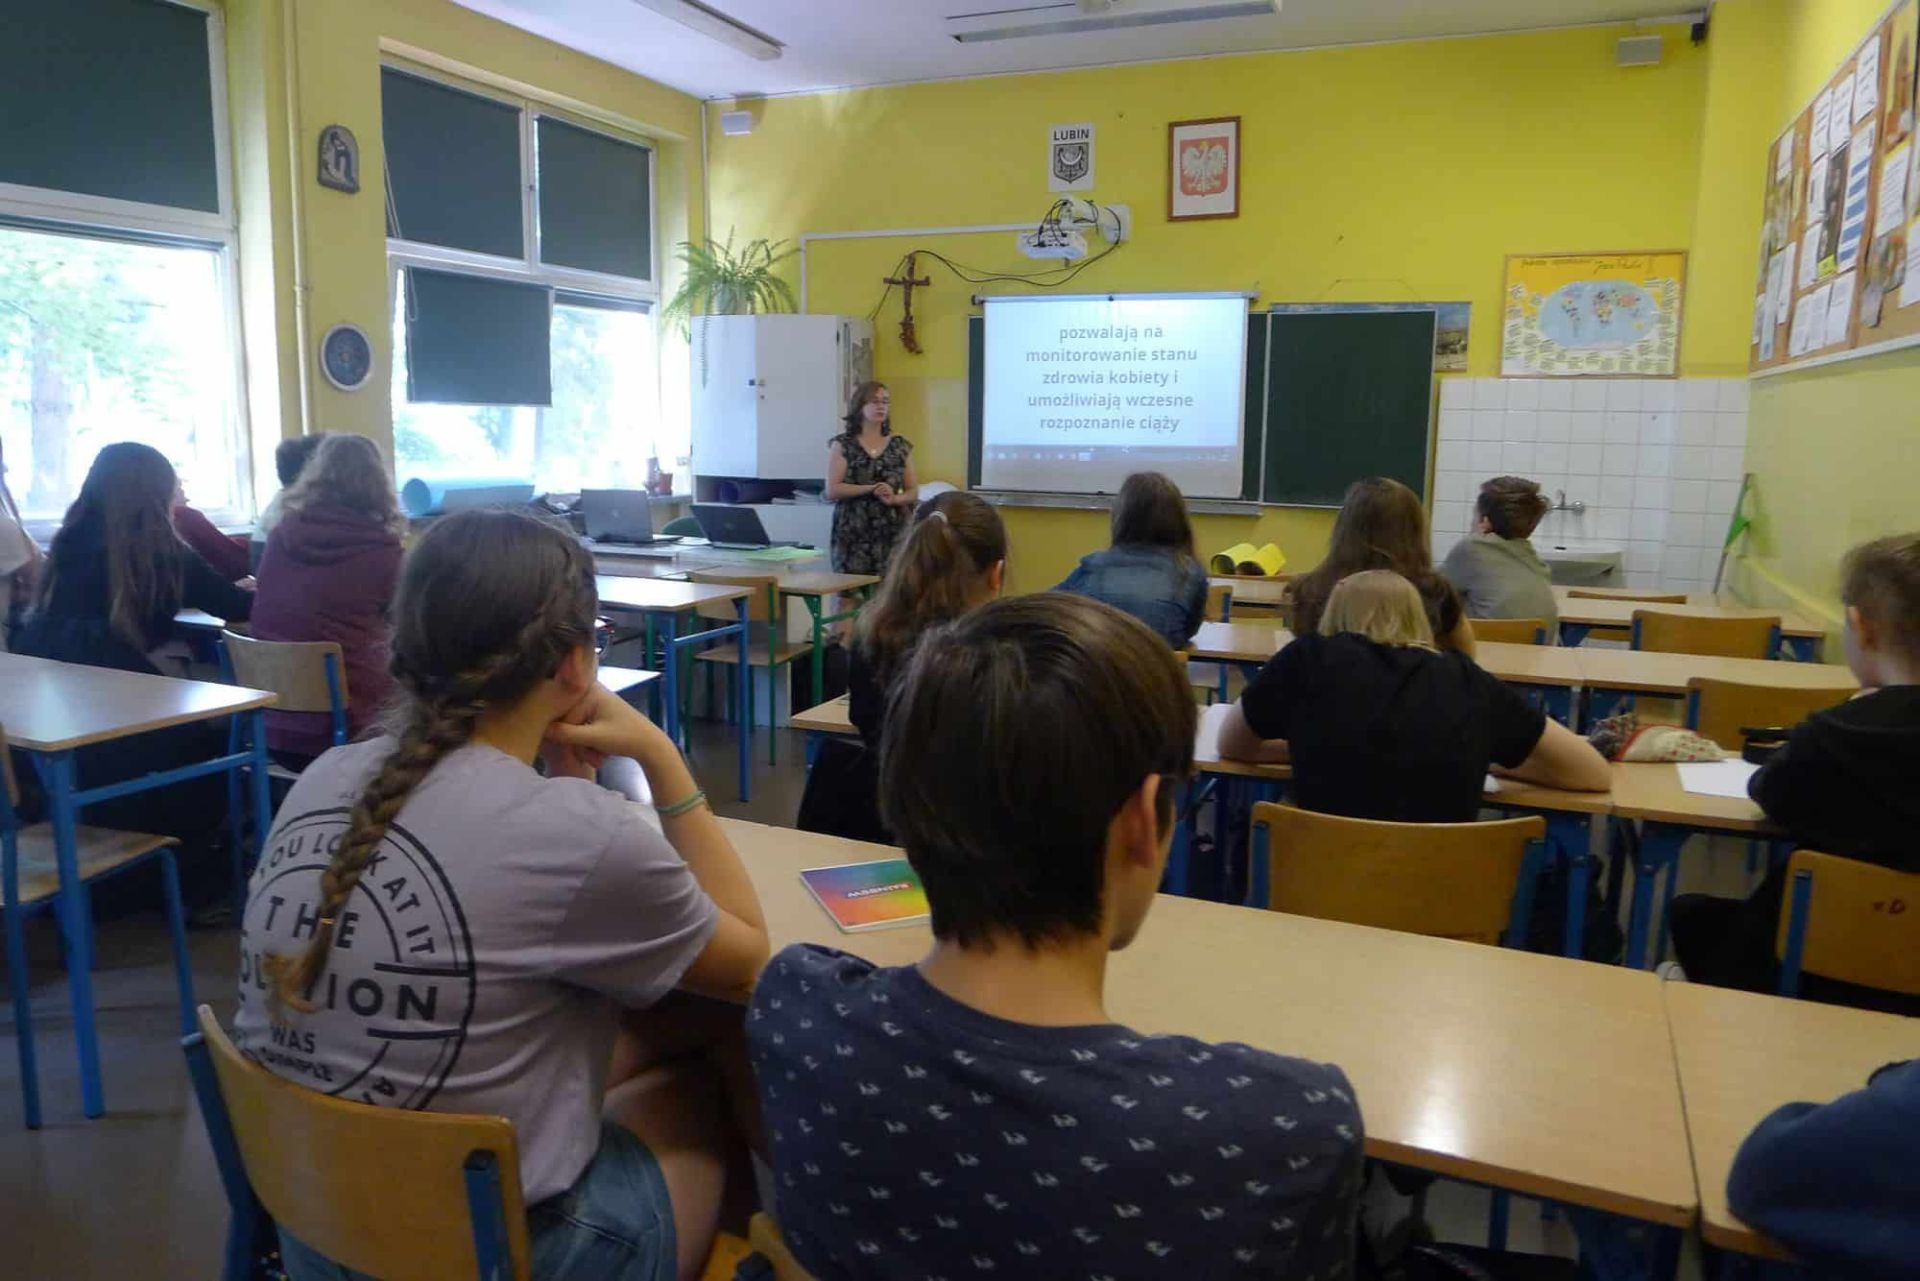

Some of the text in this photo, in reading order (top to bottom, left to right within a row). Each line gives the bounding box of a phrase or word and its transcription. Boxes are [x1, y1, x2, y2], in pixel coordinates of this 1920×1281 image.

[1053, 128, 1090, 141] LUBIN
[1059, 325, 1163, 343] pozwalają na
[1026, 348, 1197, 362] monitorowanie stanu
[1042, 370, 1104, 384] zdrowia
[1109, 370, 1169, 387] kobiety
[1028, 393, 1194, 410] umożliwiają wczesne
[1040, 416, 1180, 433] rozpoznanie ciąży
[260, 834, 304, 878] OU
[383, 877, 421, 913] AT
[406, 925, 435, 954] IT
[265, 895, 360, 949] THE
[271, 1022, 316, 1054] WAS
